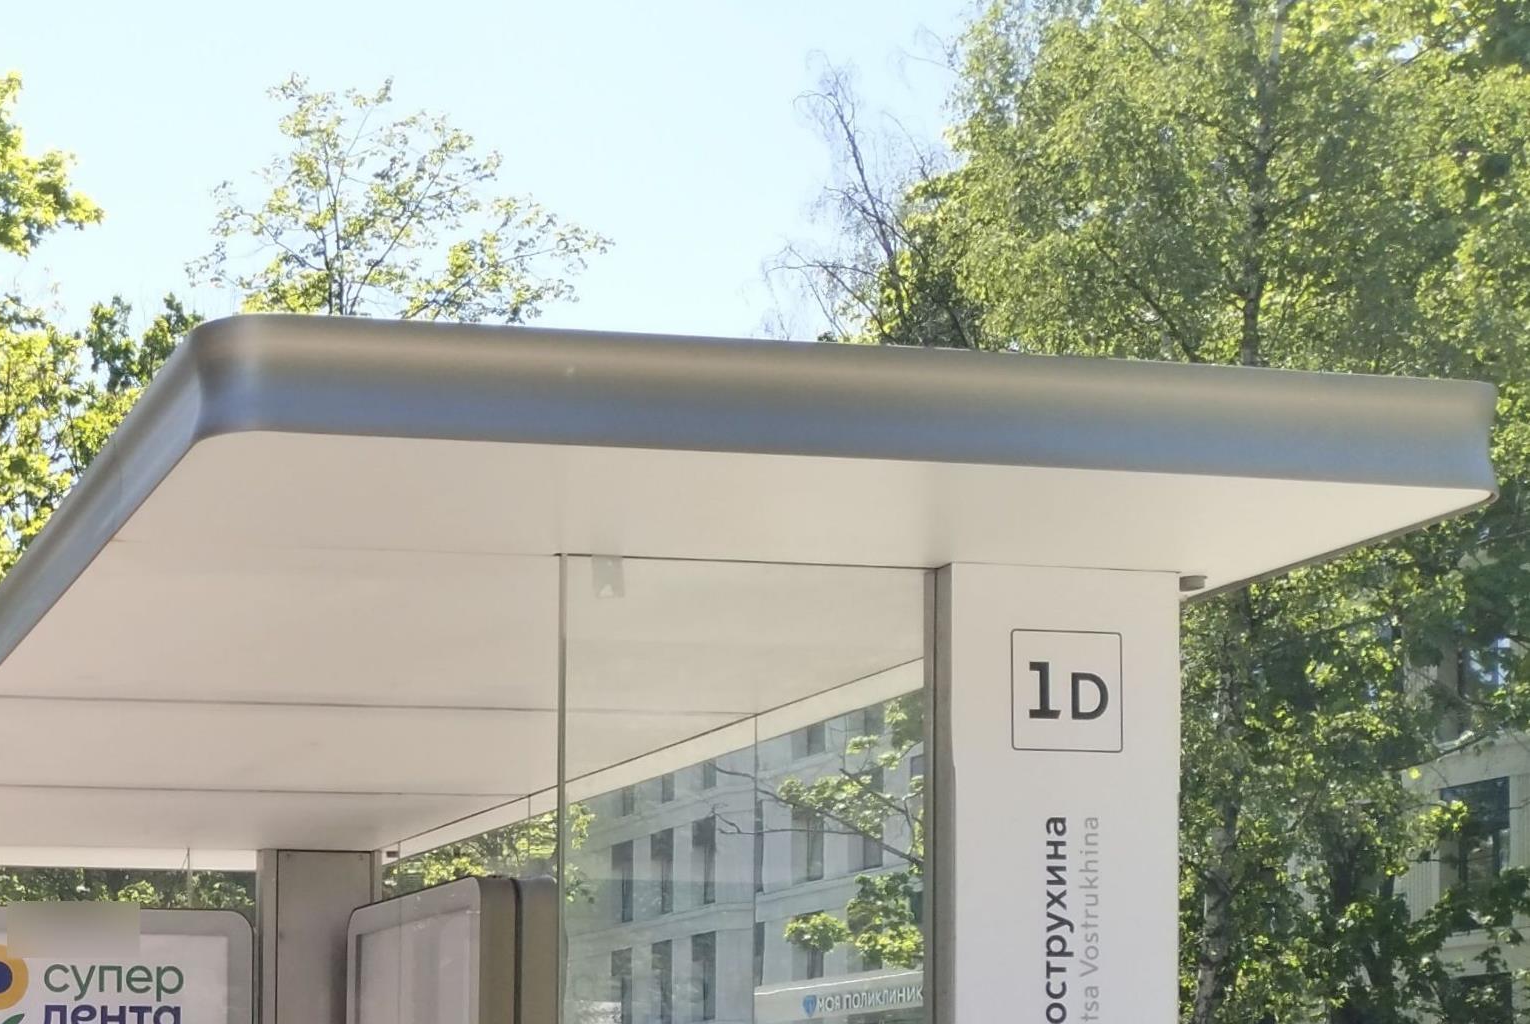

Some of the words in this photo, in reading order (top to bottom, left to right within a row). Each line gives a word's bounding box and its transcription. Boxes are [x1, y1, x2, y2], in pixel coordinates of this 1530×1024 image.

[1028, 661, 1109, 721] 1D
[1079, 815, 1100, 977] Vostrukhina
[43, 964, 184, 1001] супер
[817, 995, 841, 1013] МОЯ
